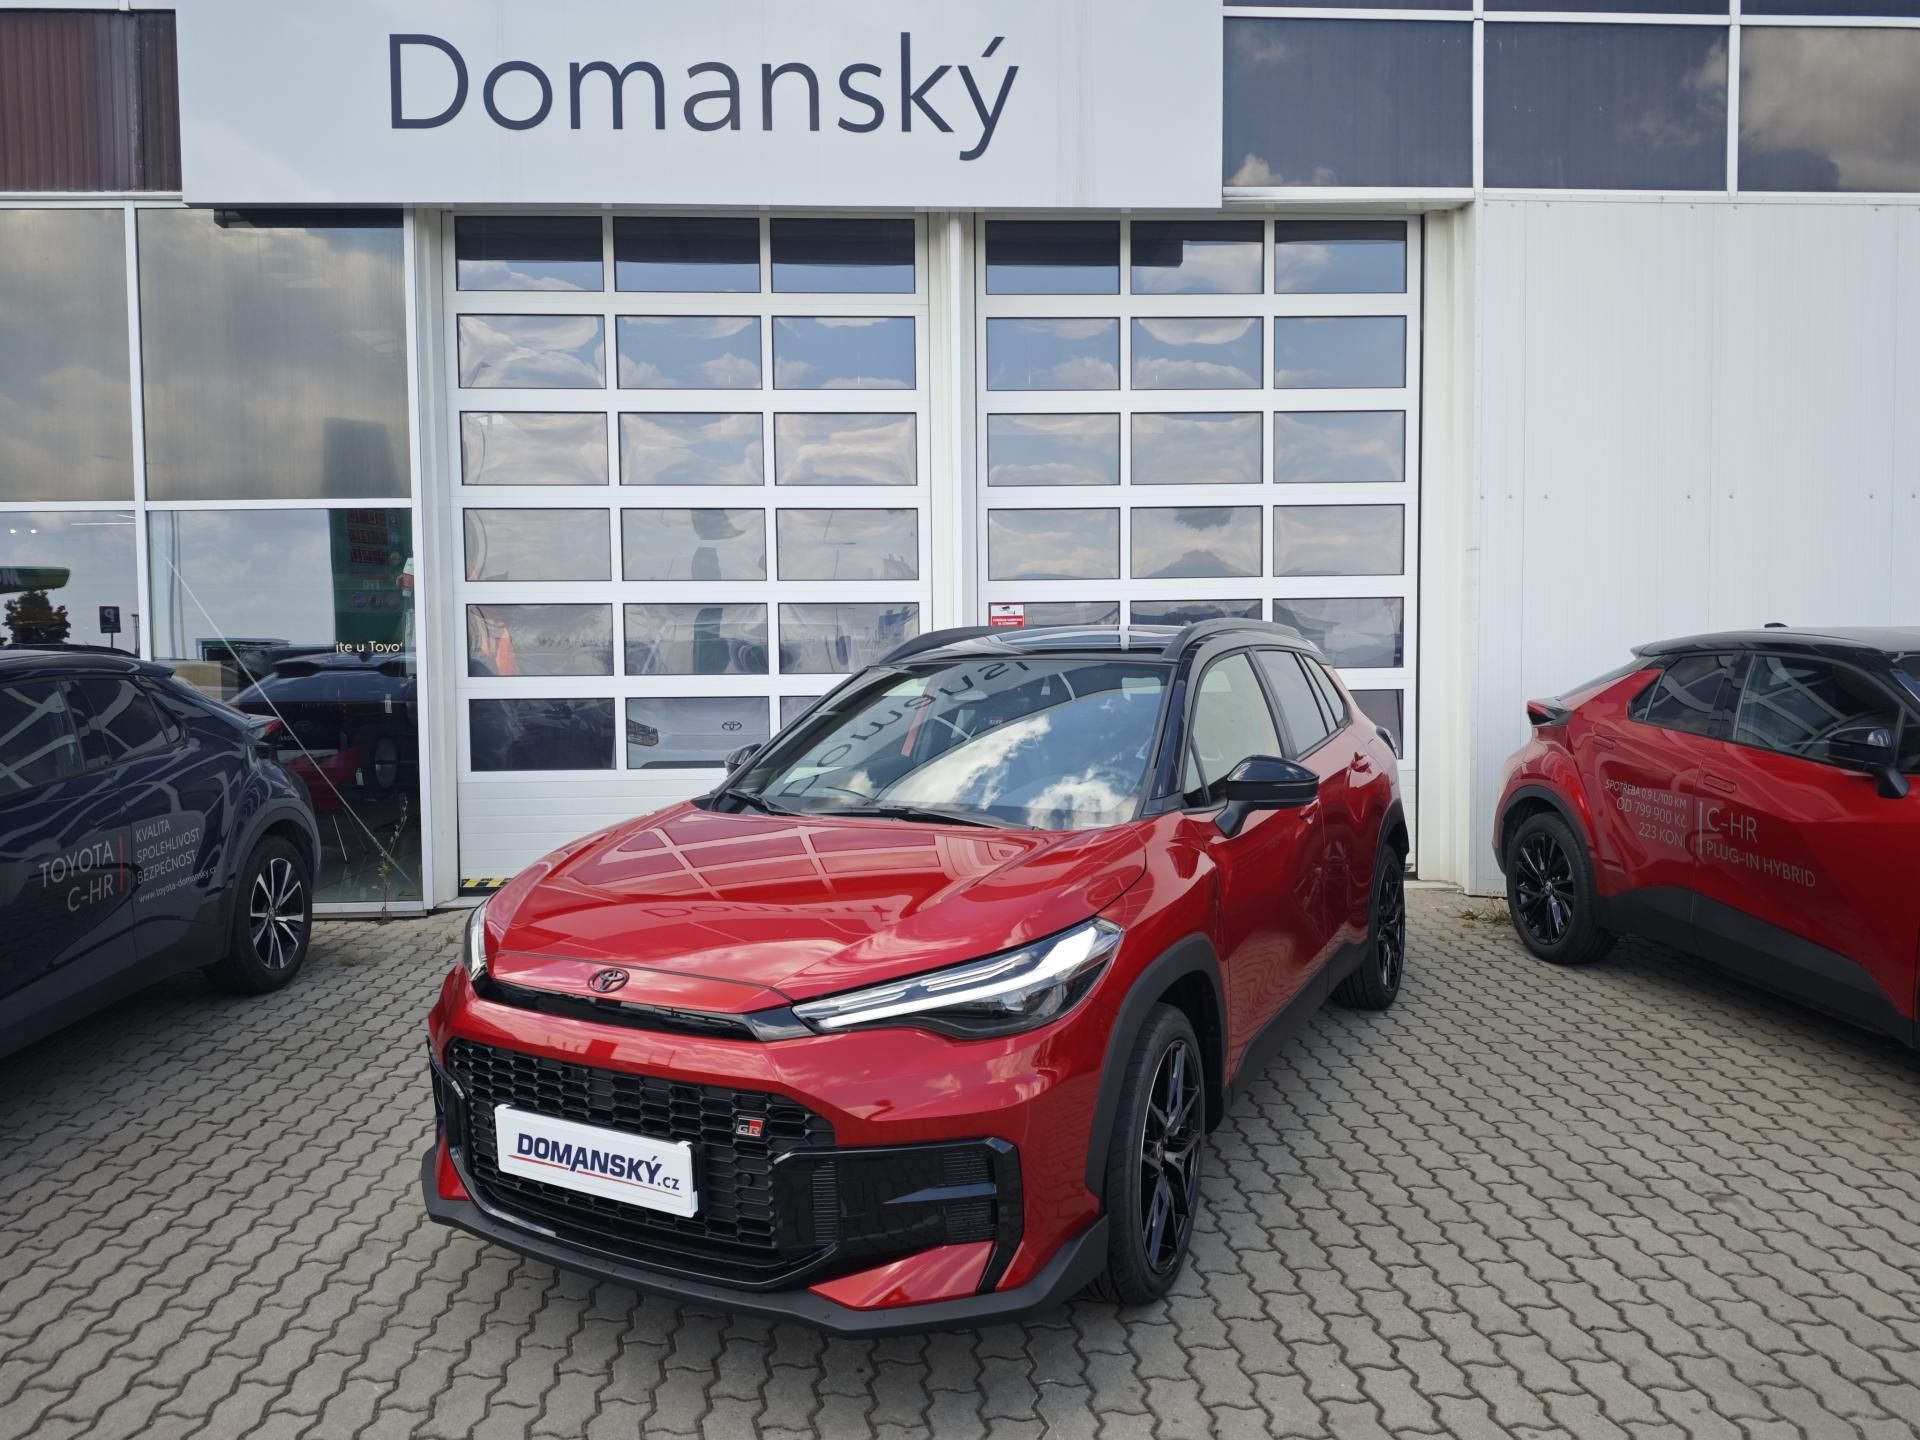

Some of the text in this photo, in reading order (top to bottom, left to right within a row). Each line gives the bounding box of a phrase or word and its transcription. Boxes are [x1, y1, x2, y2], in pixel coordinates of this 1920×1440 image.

[388, 31, 1020, 162] Domanský
[368, 640, 403, 654] Toyo
[1616, 796, 1632, 812] OD
[1635, 801, 1652, 818] 799
[1654, 806, 1672, 825] 900
[1641, 788, 1653, 801] 0,9
[1653, 791, 1673, 807] L/100
[1674, 796, 1687, 809] KM
[135, 819, 171, 843] KVALITA
[1639, 822, 1657, 839] 223
[1706, 807, 1758, 844] C-HR
[136, 828, 200, 864] SPOLEHLIVOST
[1706, 840, 1816, 888] PLUG-IN HYBRID
[38, 840, 115, 889] TOYOTA
[137, 849, 196, 885] BEZPEČNOST
[67, 874, 115, 912] C-HR
[737, 1123, 761, 1136] GR
[516, 1132, 680, 1191] DOMANSKÝ.cz
